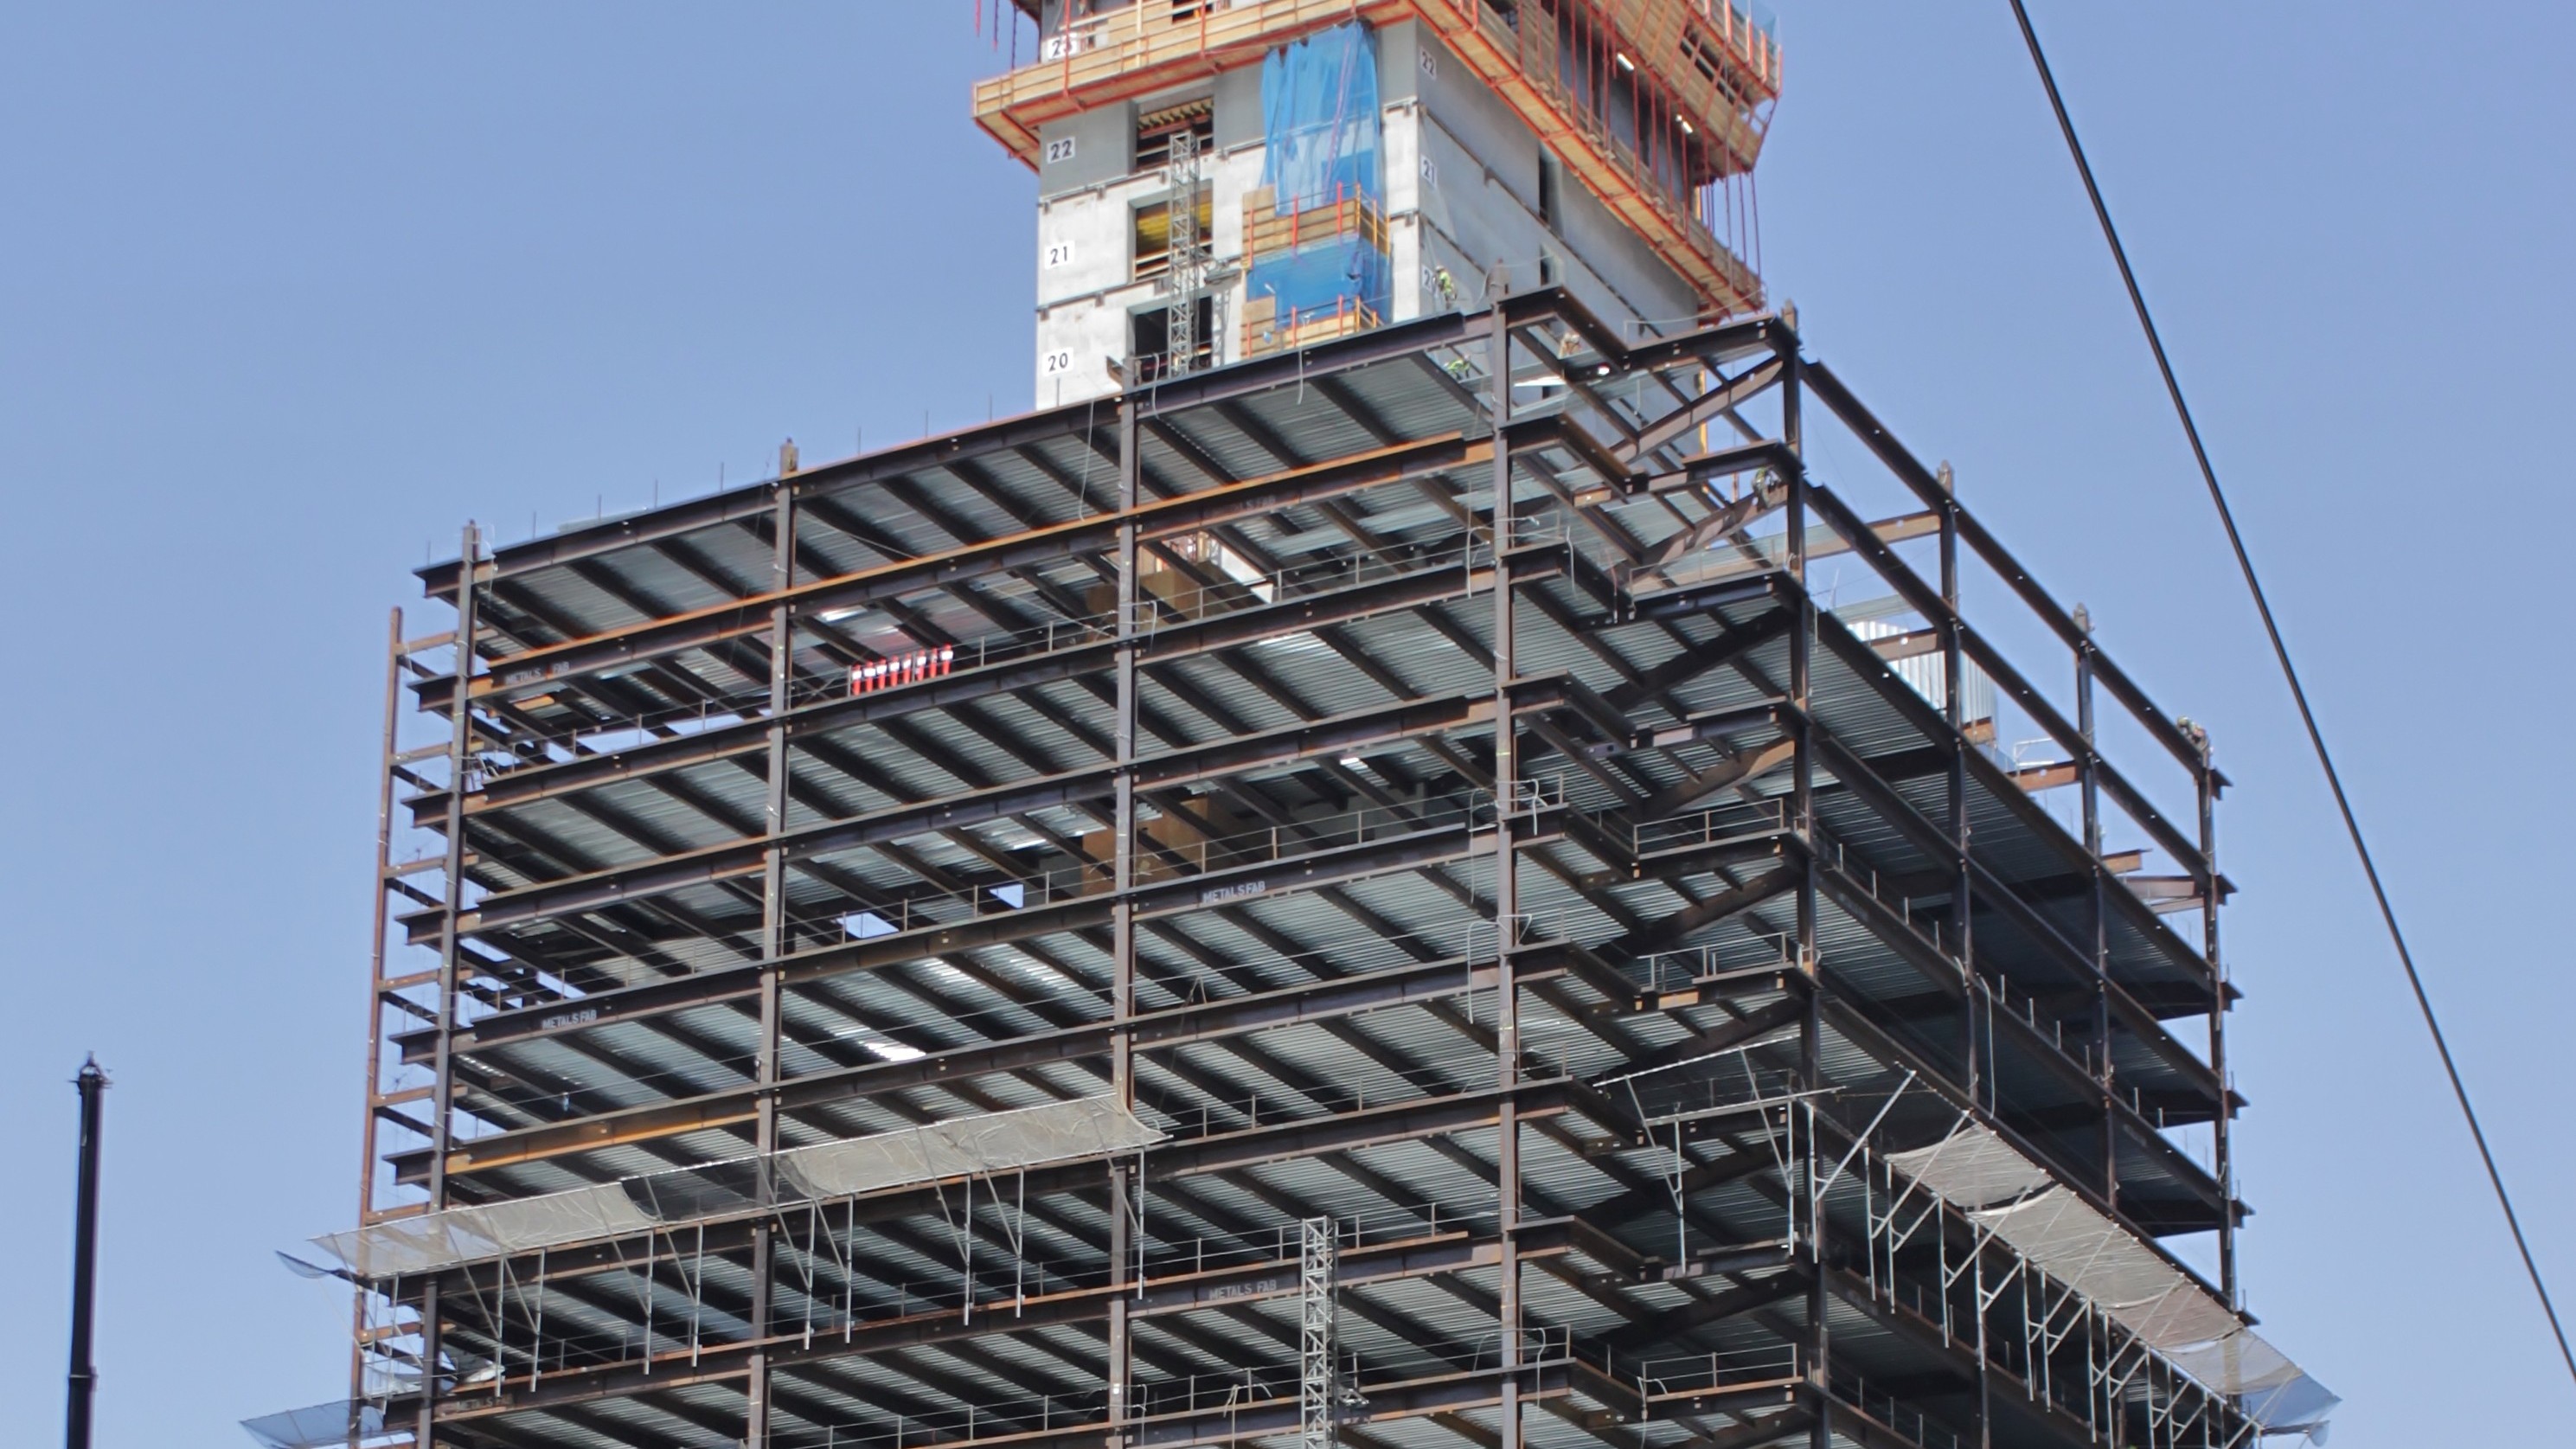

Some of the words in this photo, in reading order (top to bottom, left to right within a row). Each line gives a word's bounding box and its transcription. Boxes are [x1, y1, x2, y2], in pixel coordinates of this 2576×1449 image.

[1422, 51, 1435, 76] 22
[1050, 139, 1072, 161] 22
[1423, 159, 1435, 183] 21
[1049, 246, 1067, 266] 21
[1048, 352, 1068, 372] 20
[1208, 1283, 1253, 1300] METALS
[1257, 1279, 1277, 1293] FAB
